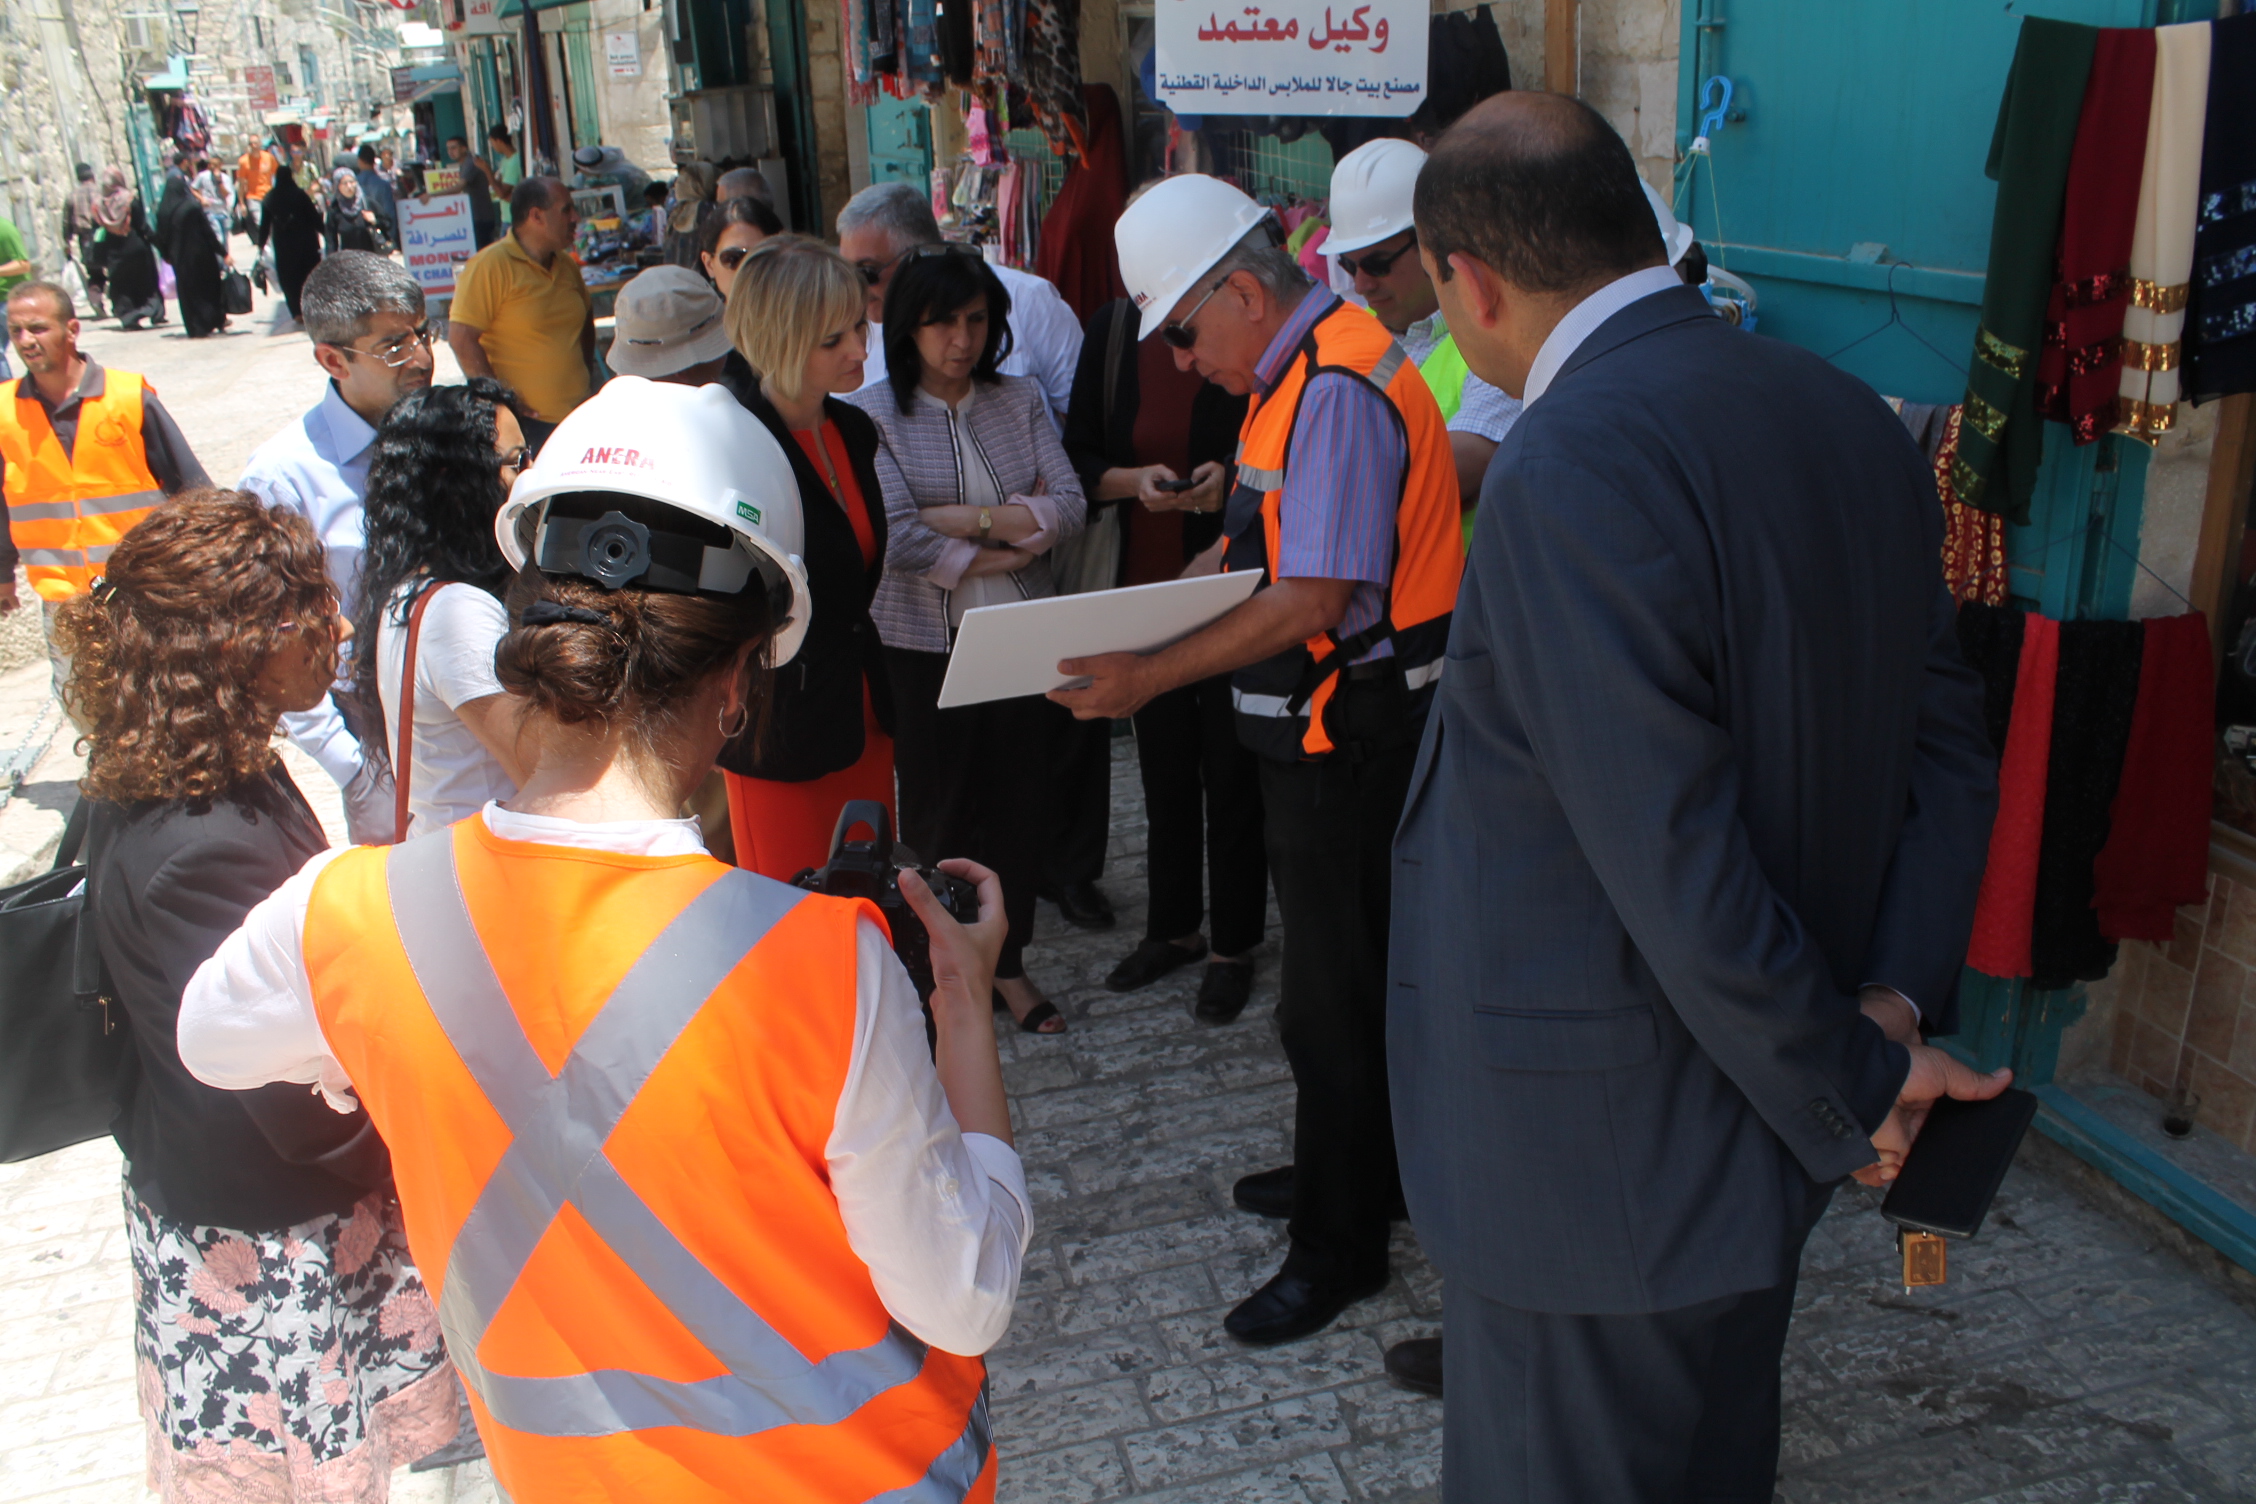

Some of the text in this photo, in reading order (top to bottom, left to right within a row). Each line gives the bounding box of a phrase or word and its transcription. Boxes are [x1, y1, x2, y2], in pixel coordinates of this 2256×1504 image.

[1198, 5, 1390, 54] وكيل معتمد
[1159, 73, 1420, 99] مصنع بيت جالا للملابس الداخلية القطنية
[580, 446, 654, 470] ANERA
[738, 505, 759, 523] MSA
